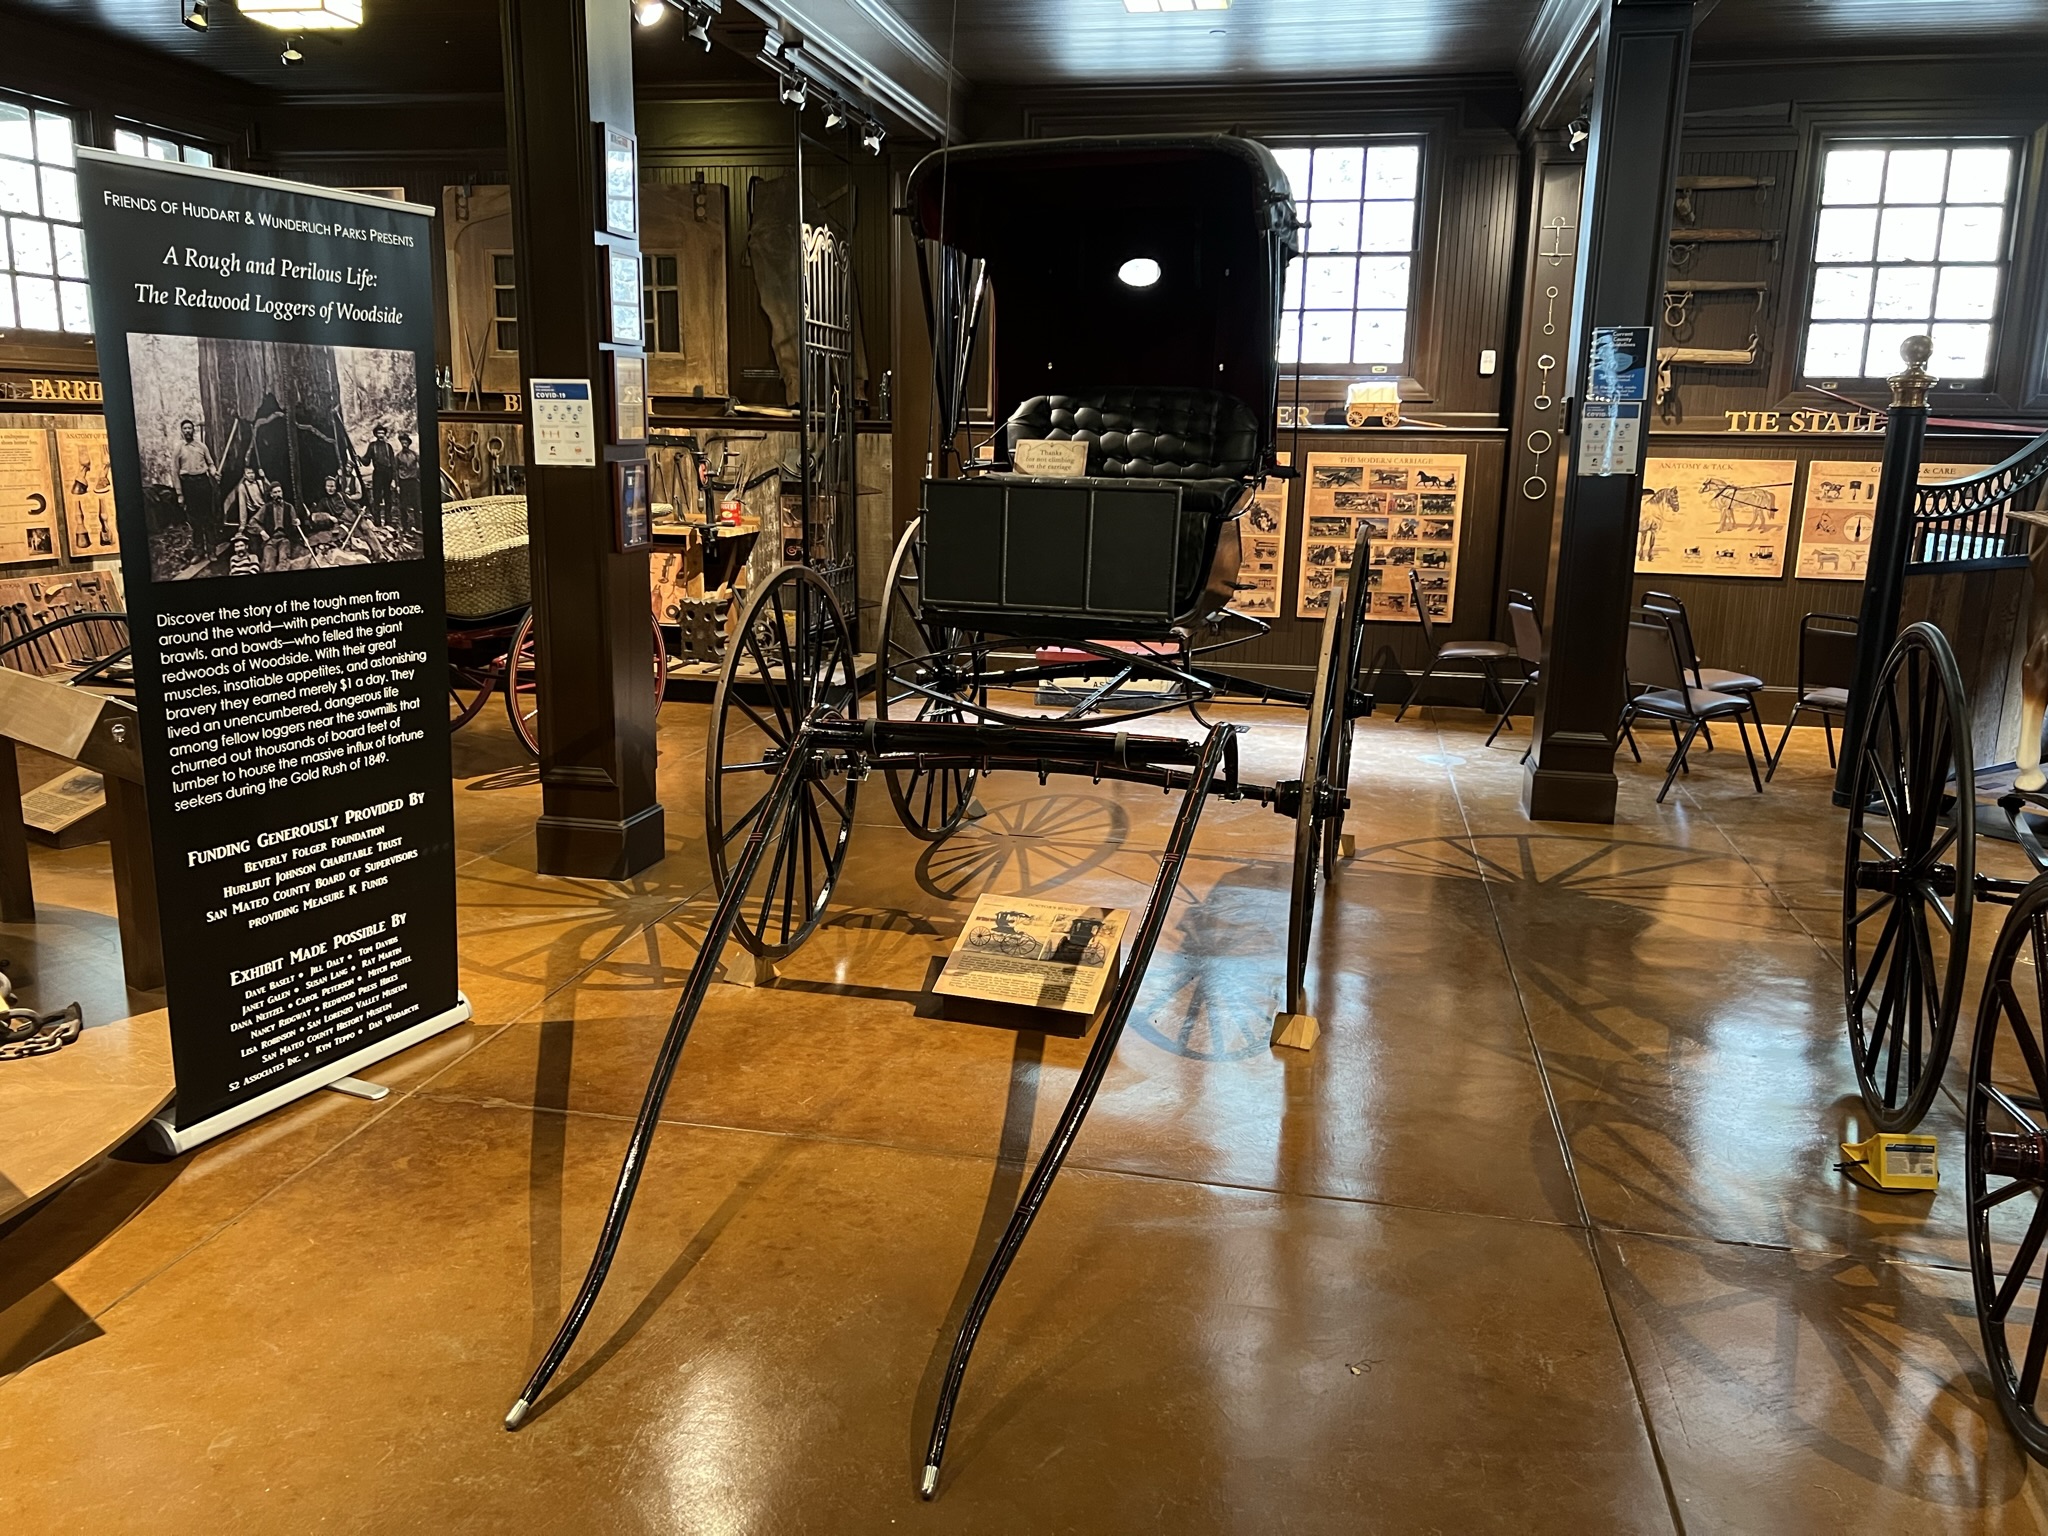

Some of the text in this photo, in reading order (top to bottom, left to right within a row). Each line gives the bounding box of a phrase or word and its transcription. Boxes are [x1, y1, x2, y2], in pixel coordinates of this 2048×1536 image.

[103, 190, 414, 248] FRIENDS OF HUDDART & WUNDERLICH PARKS PRESENTS
[162, 245, 378, 292] A Rough and Perilous Life:
[134, 283, 403, 325] The Redwood Loggers of Woodside
[1724, 410, 1780, 432] TIE
[1393, 457, 1434, 465] CARRIAGE
[1658, 462, 1701, 470] ANATOMY
[1711, 463, 1734, 471] TACK
[156, 590, 400, 627] Discover the story of the tough men from
[162, 637, 397, 684] redwoods of Woodside. With their great
[164, 650, 427, 702] muscles, insatiable appetites, and astonishing
[165, 668, 415, 721] bravery they earned merely $1 a day. They
[167, 685, 400, 739] lived an unencumbered, dangerous life
[169, 697, 421, 757] among fellow loggers near the sawmills that
[174, 751, 390, 812] seekers during the Gold Rush of 1849.
[187, 792, 425, 868] FUNDING GENEROUSLY PROVIDED BY
[243, 825, 385, 874] BEVERLY FOLGER FOUNDATION
[206, 849, 419, 923] SAN MATEO COUNTY BOARD OF SUPERVISORS
[223, 836, 403, 899] HURLBUT JOHNSON CHARITABLE TRUST
[248, 875, 389, 929] PROVIDING MEASURE K FUNDS
[229, 912, 407, 987] EXHIBIT MADE POSSIBLE BY
